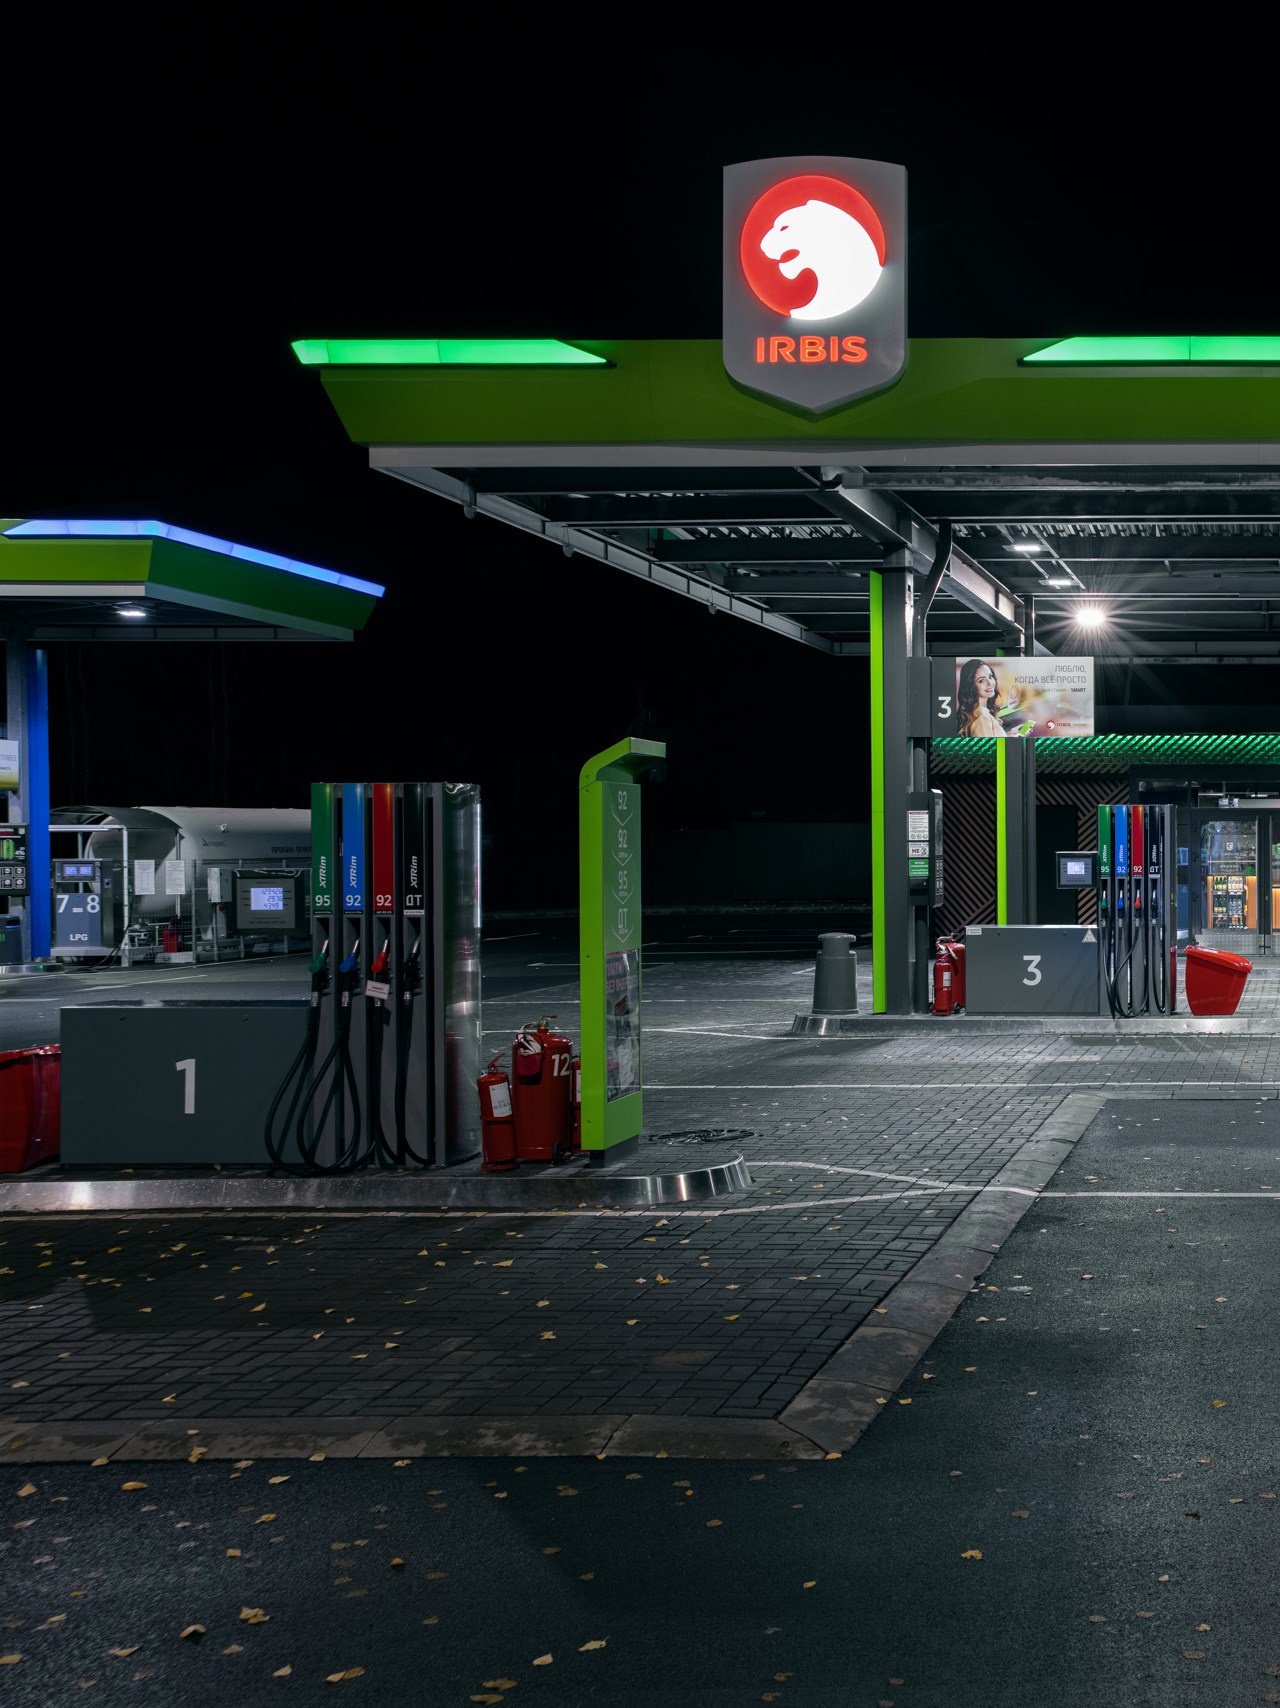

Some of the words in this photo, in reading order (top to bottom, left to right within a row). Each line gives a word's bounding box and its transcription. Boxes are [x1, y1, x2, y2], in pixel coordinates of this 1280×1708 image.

[756, 335, 868, 364] IRBIS
[1055, 665, 1086, 673] ЛЮБЛЮ,
[1015, 676, 1039, 684] КОГДА
[1041, 675, 1055, 683] ВСЁ
[938, 696, 952, 718] 3
[618, 791, 627, 810] 92
[618, 829, 627, 848] 92
[618, 871, 628, 889] 95
[56, 895, 69, 913] 7
[87, 895, 100, 913] 8
[315, 895, 331, 906] 95
[346, 895, 361, 906] 92
[376, 895, 392, 906] 92
[1023, 955, 1042, 986] 3
[551, 1053, 570, 1077] 12
[175, 1059, 196, 1114] 1
